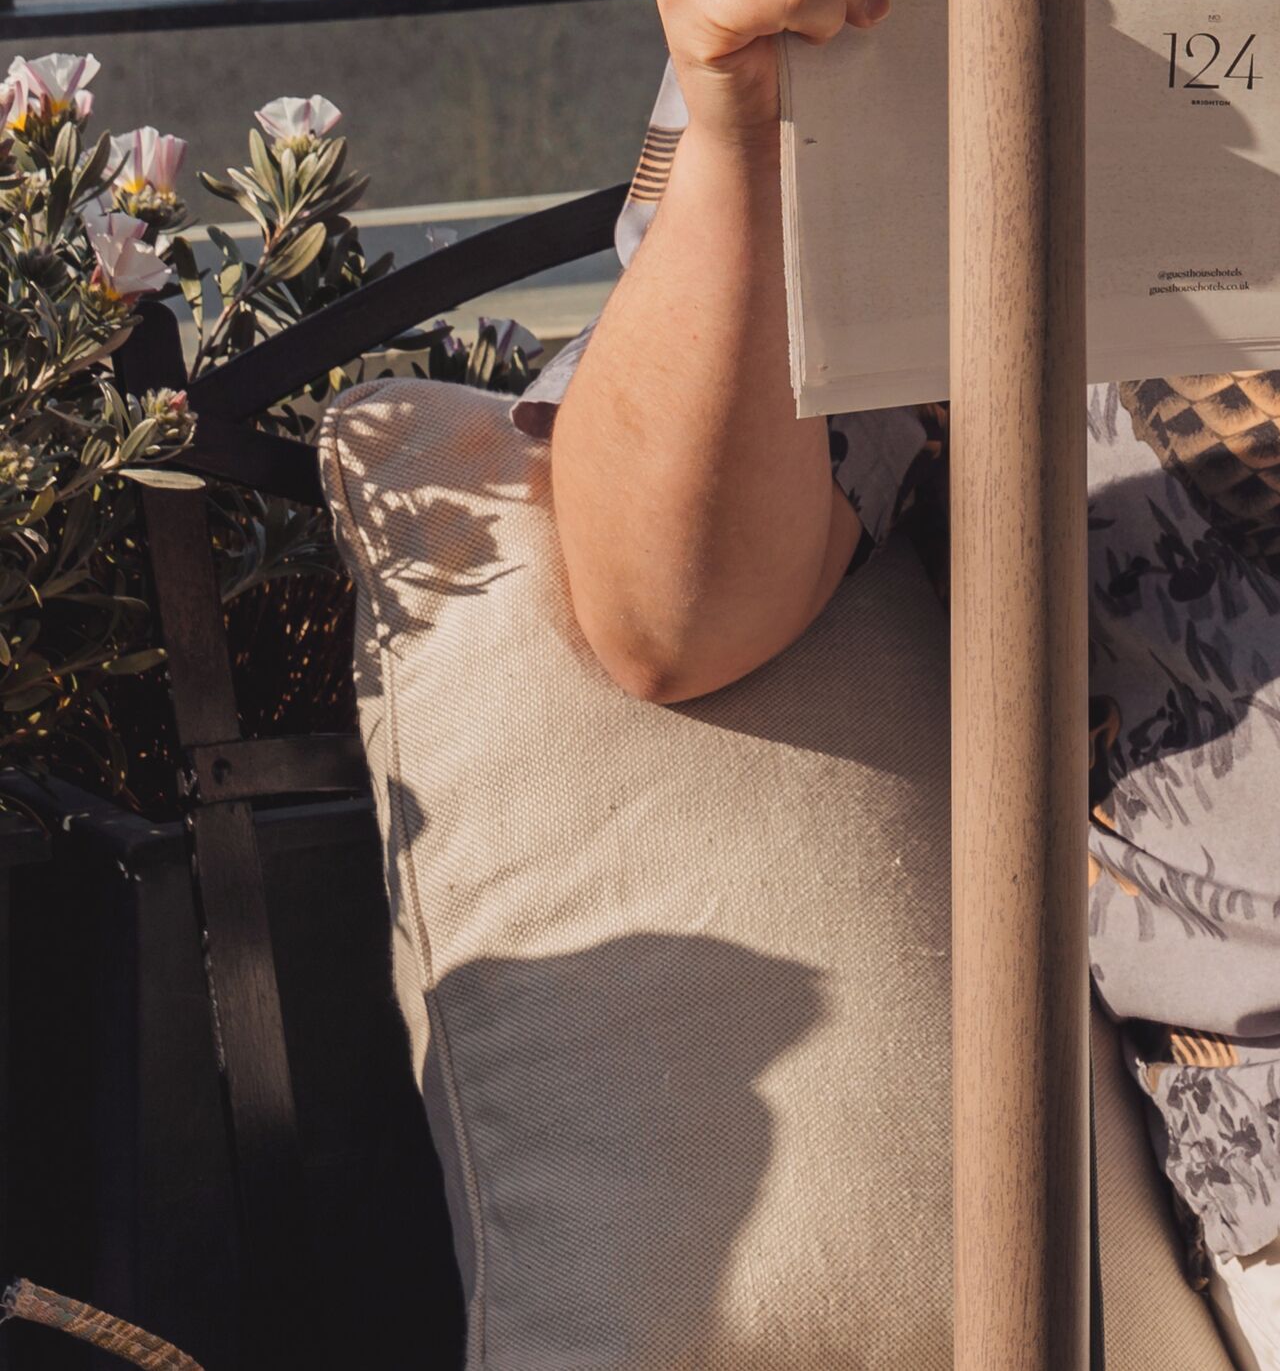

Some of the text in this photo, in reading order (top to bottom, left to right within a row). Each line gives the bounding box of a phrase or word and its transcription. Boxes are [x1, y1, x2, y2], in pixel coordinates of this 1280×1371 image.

[1162, 32, 1264, 90] 124
[1191, 99, 1231, 107] BRIGHTON
[1157, 268, 1242, 280] @guesthousehotels
[1149, 281, 1250, 296] guesthousehotels.co.uk
